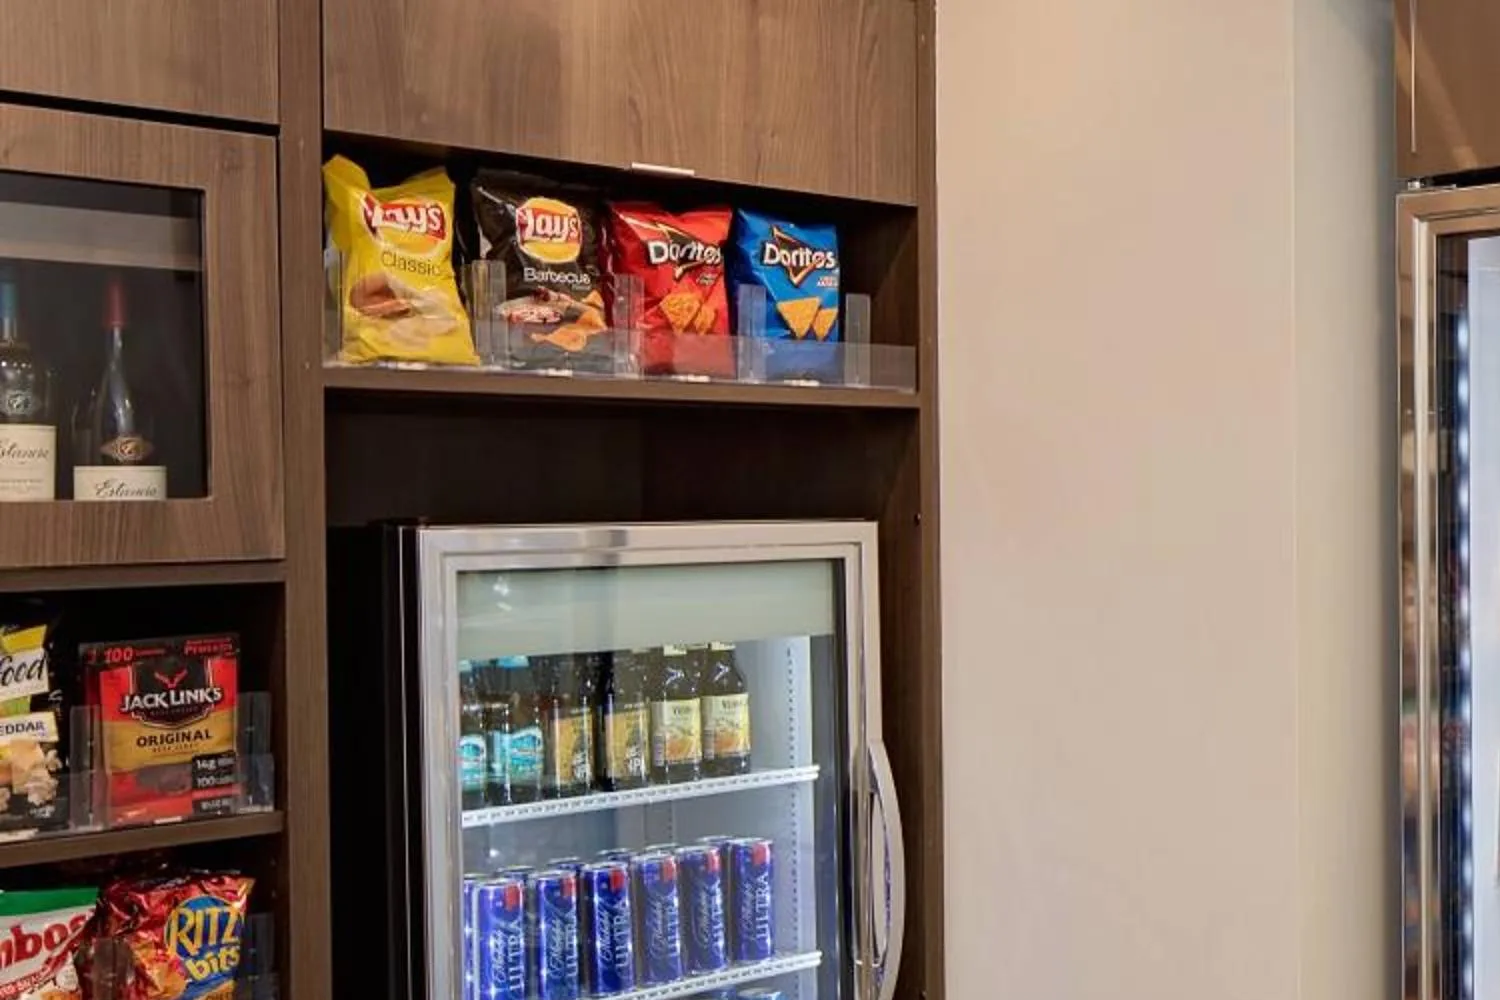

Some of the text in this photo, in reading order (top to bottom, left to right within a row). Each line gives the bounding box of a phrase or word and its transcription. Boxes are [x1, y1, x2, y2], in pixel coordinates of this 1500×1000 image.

[381, 251, 442, 276] Classic
[648, 240, 722, 265] Doritos
[763, 242, 837, 269] Doritos
[524, 267, 591, 284] Barbecue
[121, 692, 168, 712] JACK
[0, 720, 45, 736] EDDAR
[136, 728, 213, 747] ORIGINAL
[755, 871, 770, 939] ULTRA
[169, 907, 244, 955] RITZ
[612, 897, 631, 968] ULTRA
[185, 948, 240, 981] bits
